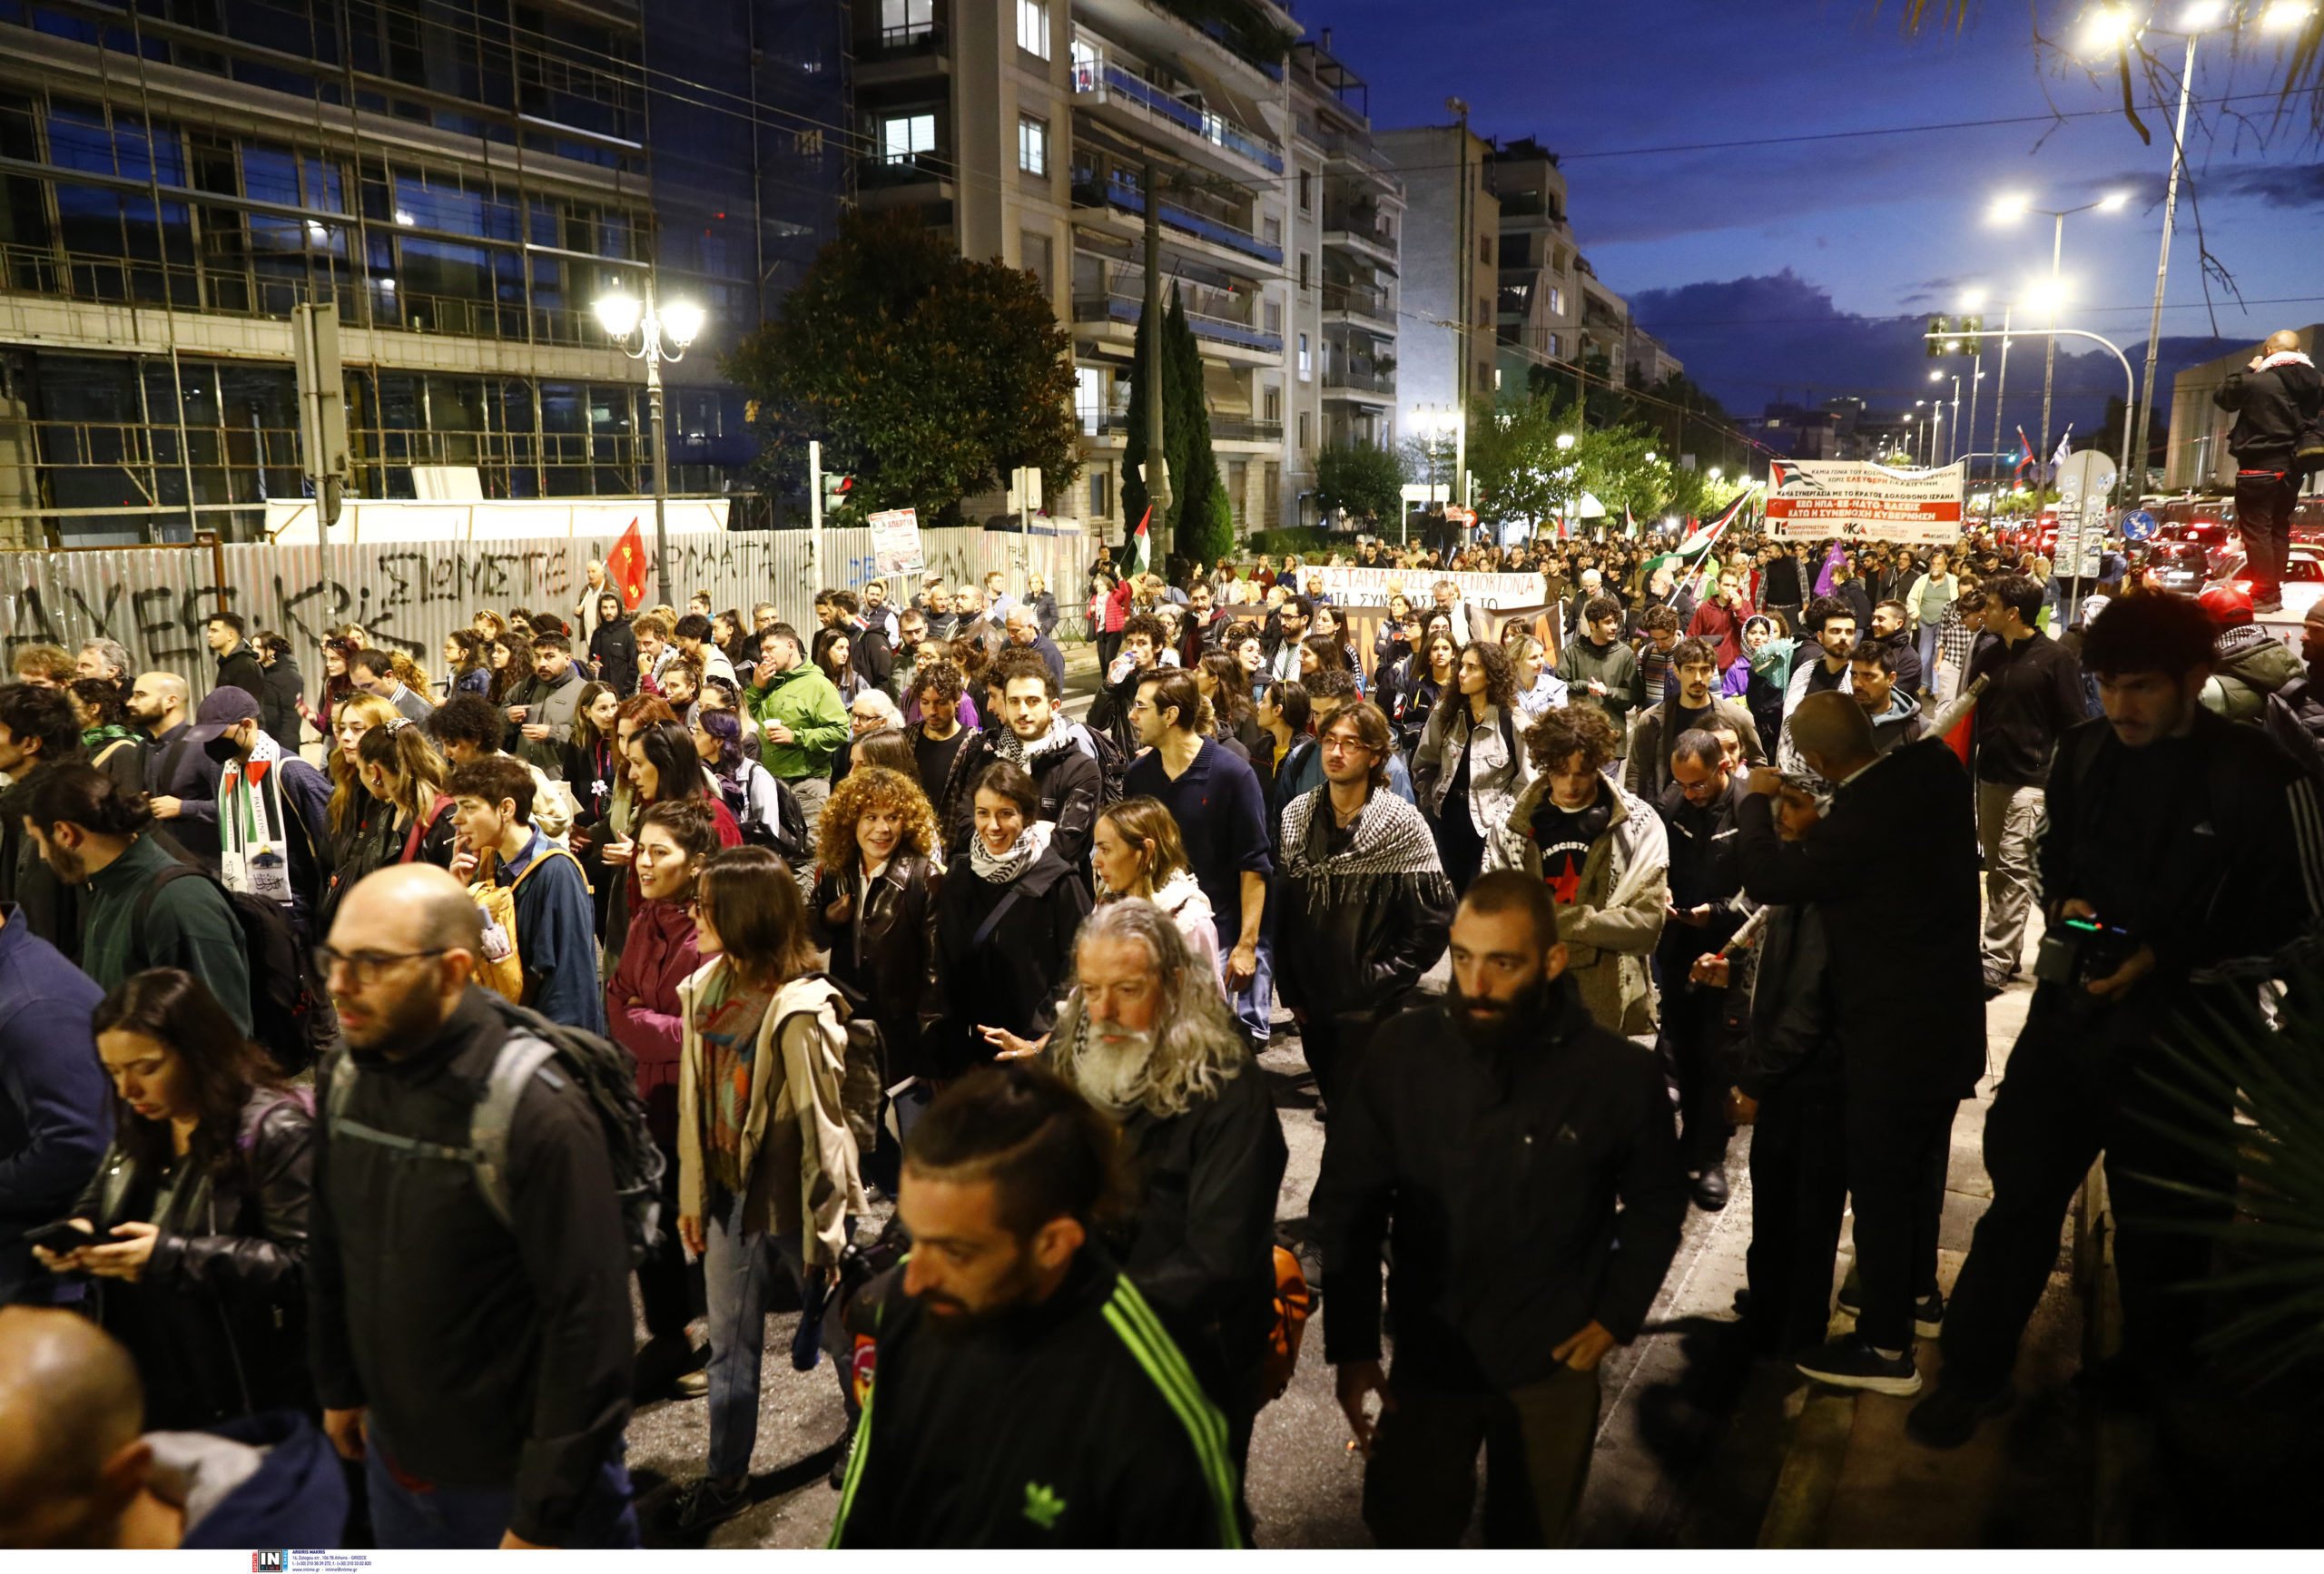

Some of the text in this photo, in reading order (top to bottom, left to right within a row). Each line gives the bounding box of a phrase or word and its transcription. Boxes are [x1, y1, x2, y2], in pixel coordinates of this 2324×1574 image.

[1846, 476, 1887, 485] ΕΛΕΥΘΕΡΗ
[1787, 509, 1936, 521] ΚΑΤΩ Η ΣΥΝΕΝΟΧΗ ΚΥΒΕΡΝΗΣΗ
[888, 518, 914, 528] ΑΠΕΡΓΙΑ
